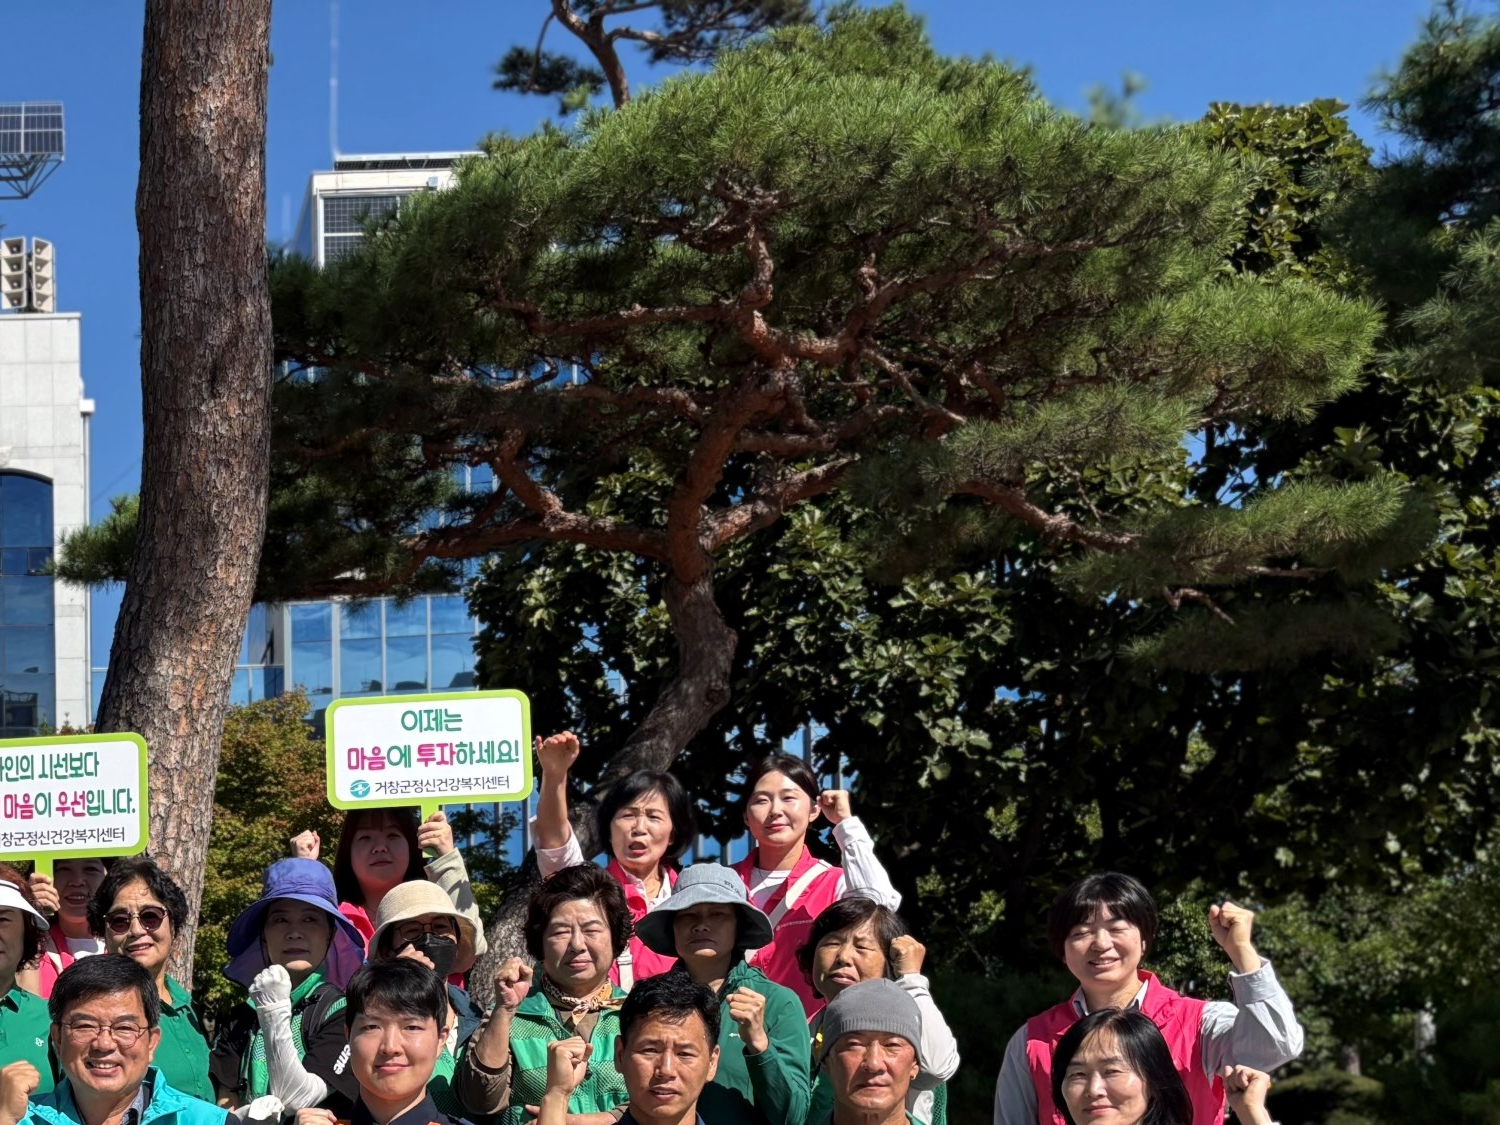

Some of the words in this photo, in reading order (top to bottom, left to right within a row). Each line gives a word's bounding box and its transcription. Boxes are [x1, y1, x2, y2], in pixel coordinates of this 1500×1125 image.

[401, 708, 463, 733] 이제는
[38, 751, 100, 780] 시선보다
[347, 744, 412, 771] 마음에
[416, 739, 520, 767] 투자하세요!
[374, 775, 510, 795] 거창군정신건강복지센터
[3, 791, 52, 820] 마음이
[55, 788, 136, 818] 우선입니다.
